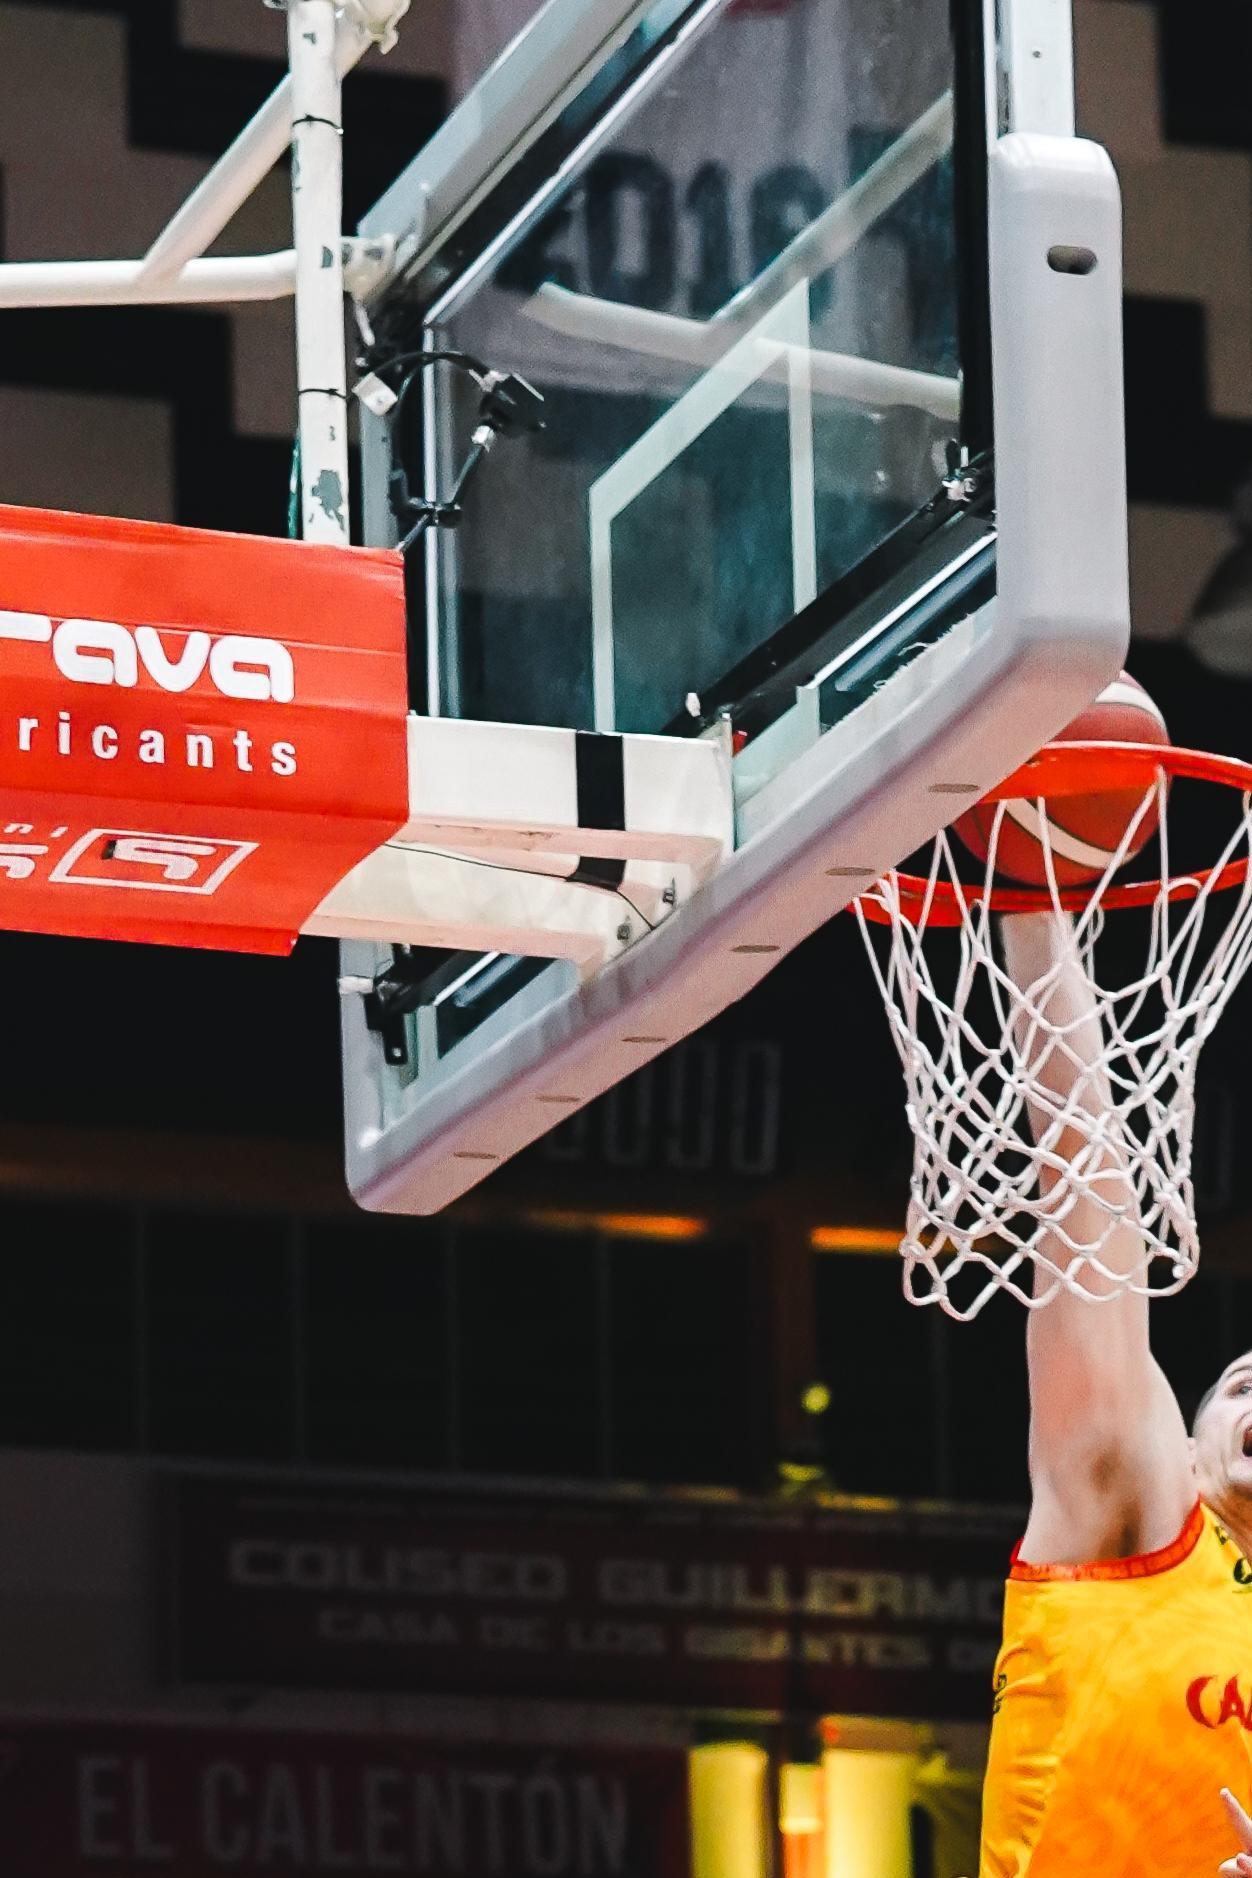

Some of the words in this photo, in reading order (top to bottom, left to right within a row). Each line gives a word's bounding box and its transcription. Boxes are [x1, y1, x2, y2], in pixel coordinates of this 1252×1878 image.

[17, 711, 298, 777] ricants
[227, 1538, 569, 1602] COLISEO
[76, 1755, 175, 1859] EL
[199, 1755, 630, 1877] CALENTÓN
